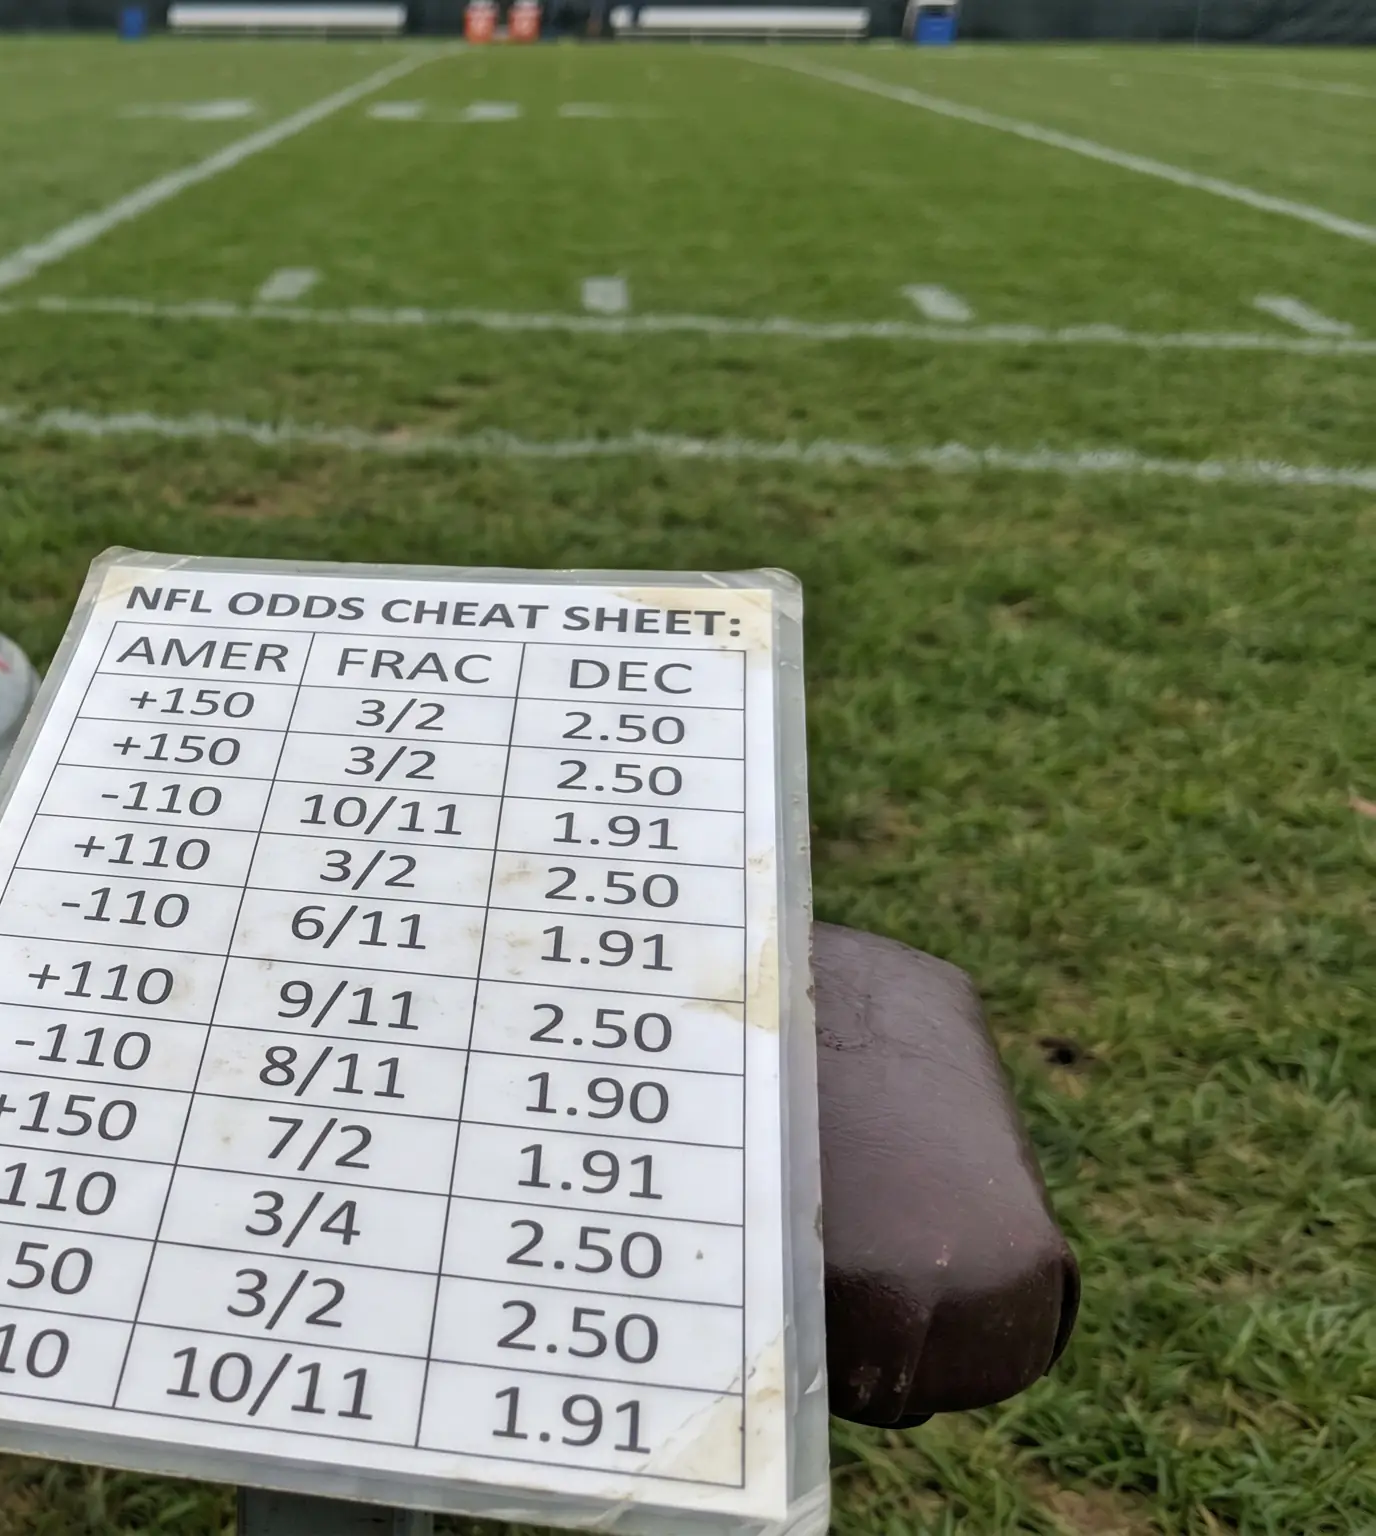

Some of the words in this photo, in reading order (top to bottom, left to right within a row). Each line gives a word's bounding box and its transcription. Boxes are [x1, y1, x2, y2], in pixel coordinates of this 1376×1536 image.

[125, 585, 213, 614] NFL
[227, 591, 365, 621] ODDS
[380, 598, 550, 630] CHEAT
[562, 605, 741, 638] SHEET:
[115, 635, 289, 673] AMER
[336, 647, 493, 685] FRAC
[569, 658, 693, 695] DEC
[129, 687, 255, 719] +150
[355, 697, 446, 734] 3/2
[561, 711, 686, 745] 2.50
[112, 732, 241, 766] +150
[343, 745, 436, 783] 3/2
[556, 759, 683, 797] 2.50
[100, 780, 223, 817] -110
[299, 793, 463, 836] 10/11
[552, 811, 679, 851] 1.91
[73, 832, 211, 871] +110
[319, 849, 417, 891] 3/2
[544, 866, 679, 909] 2.50
[61, 886, 190, 929] -110
[291, 904, 427, 950] 6/11
[540, 925, 674, 972] 1.91
[27, 960, 175, 1006] +110
[277, 979, 419, 1031] 9/11
[529, 1003, 673, 1053] 2.50
[14, 1023, 152, 1071] -110
[258, 1045, 406, 1100] 8/11
[525, 1071, 670, 1125] 1.90
[267, 1115, 373, 1172] 7/2
[517, 1143, 663, 1201] 1.91
[244, 1190, 361, 1249] 3/4
[505, 1219, 663, 1280] 2.50
[226, 1267, 346, 1331] 3/2
[496, 1299, 659, 1365] 2.50
[165, 1346, 374, 1421] 10/11
[491, 1386, 651, 1455] 1.91
